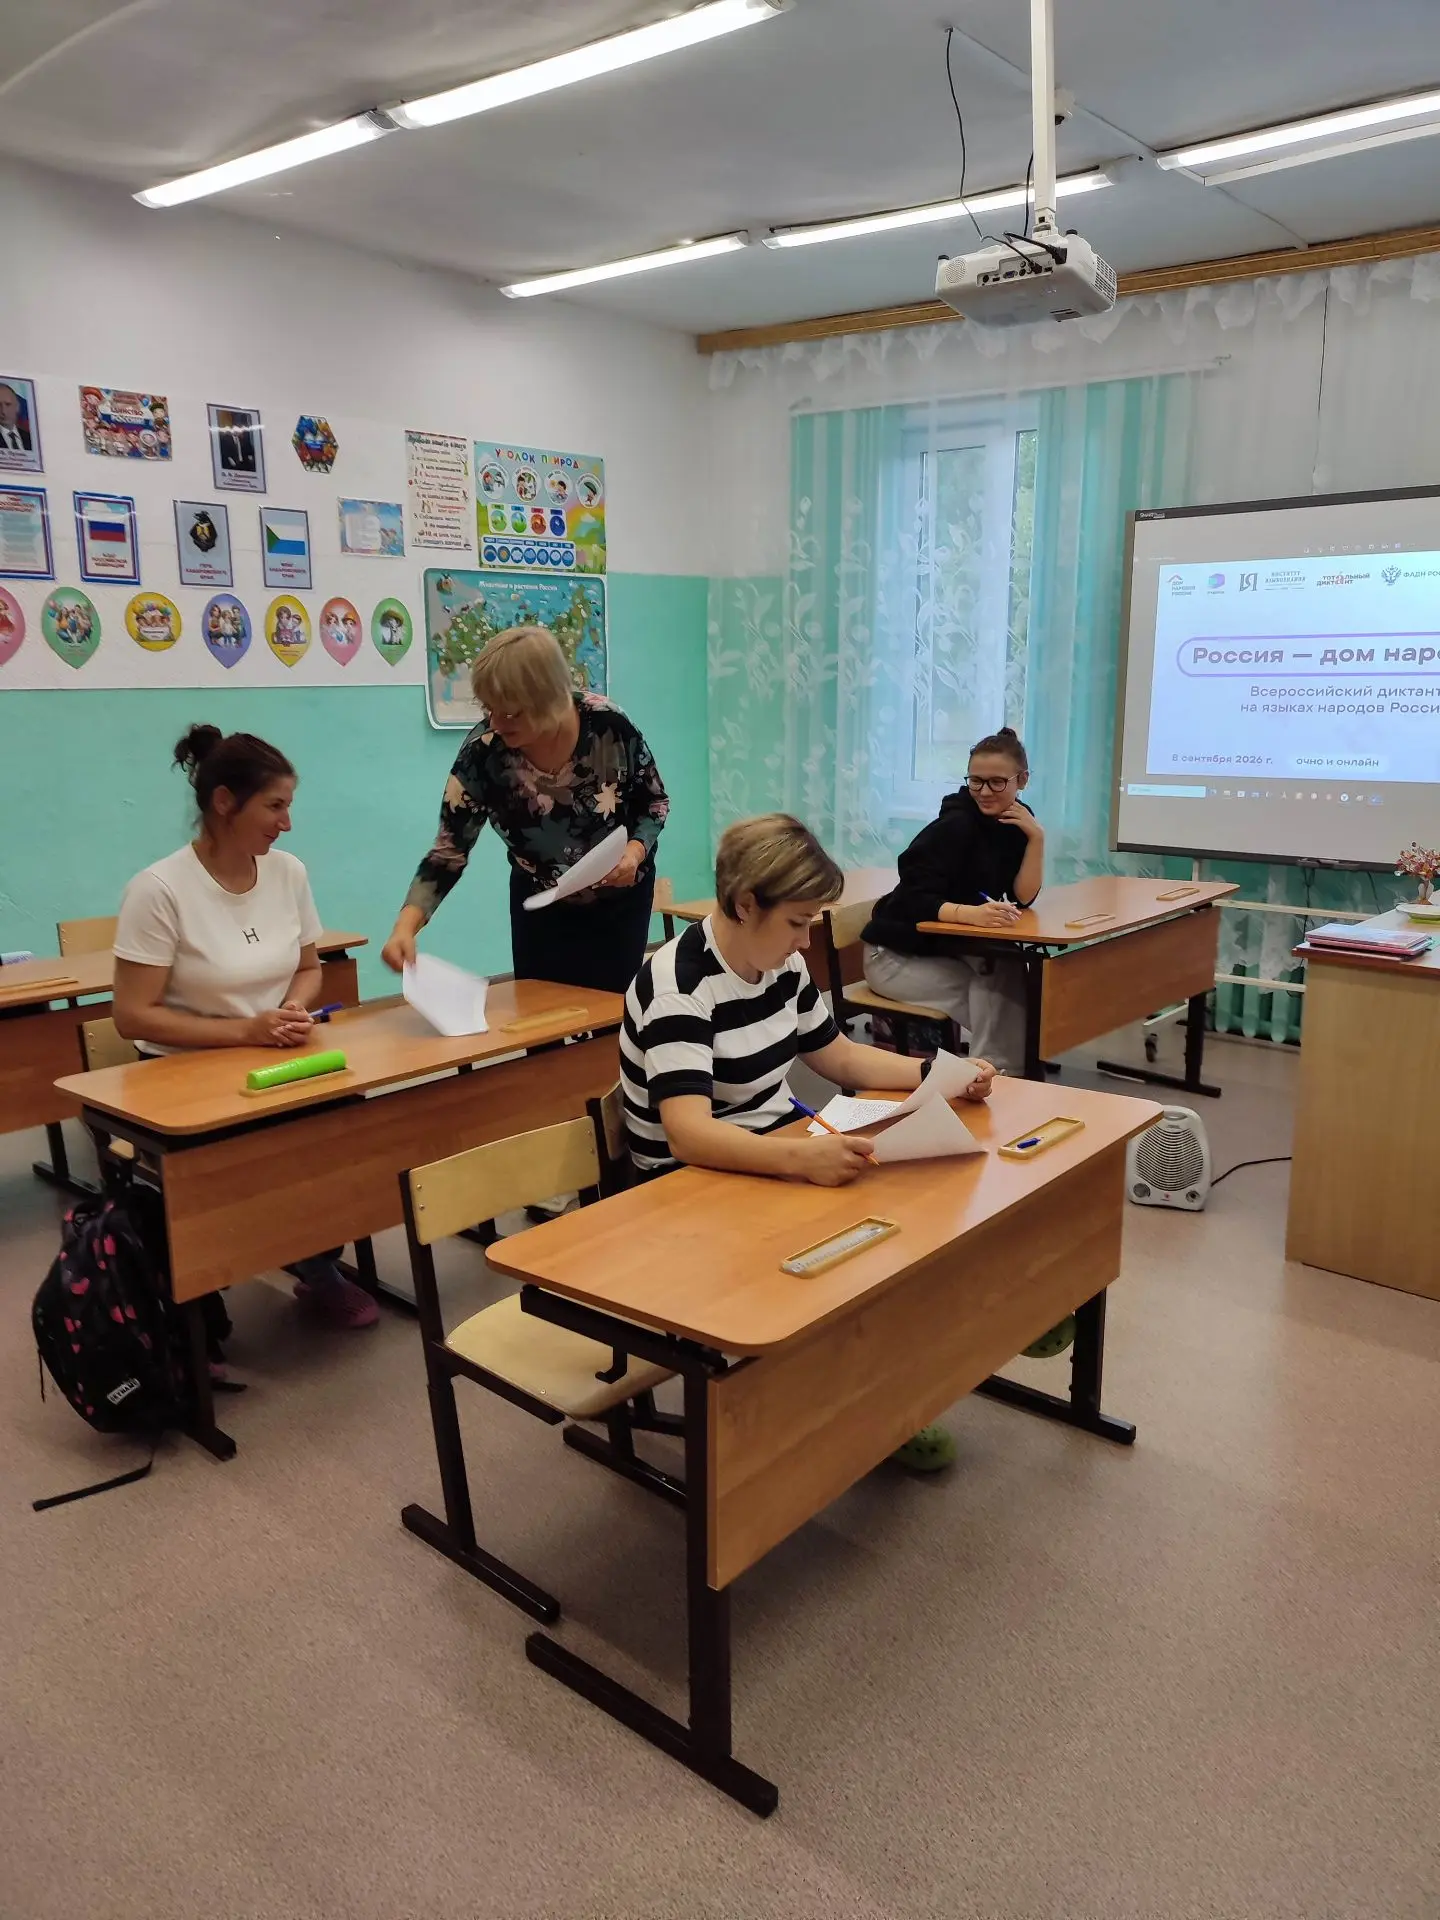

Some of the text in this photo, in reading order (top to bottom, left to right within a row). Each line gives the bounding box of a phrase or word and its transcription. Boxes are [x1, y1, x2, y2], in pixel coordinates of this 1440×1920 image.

[495, 449, 583, 469] УОЛОК ПИРОД
[1193, 647, 1284, 664] Россия
[1320, 648, 1375, 665] дом
[1384, 647, 1440, 665] нар
[1250, 685, 1373, 699] Всероссийский
[1240, 704, 1257, 713] на
[1262, 704, 1313, 713] языках
[1317, 704, 1385, 715] народов
[1181, 755, 1232, 764] сентября
[1235, 755, 1263, 764] 2026
[1336, 757, 1379, 767] онлайн
[242, 928, 260, 944] H
